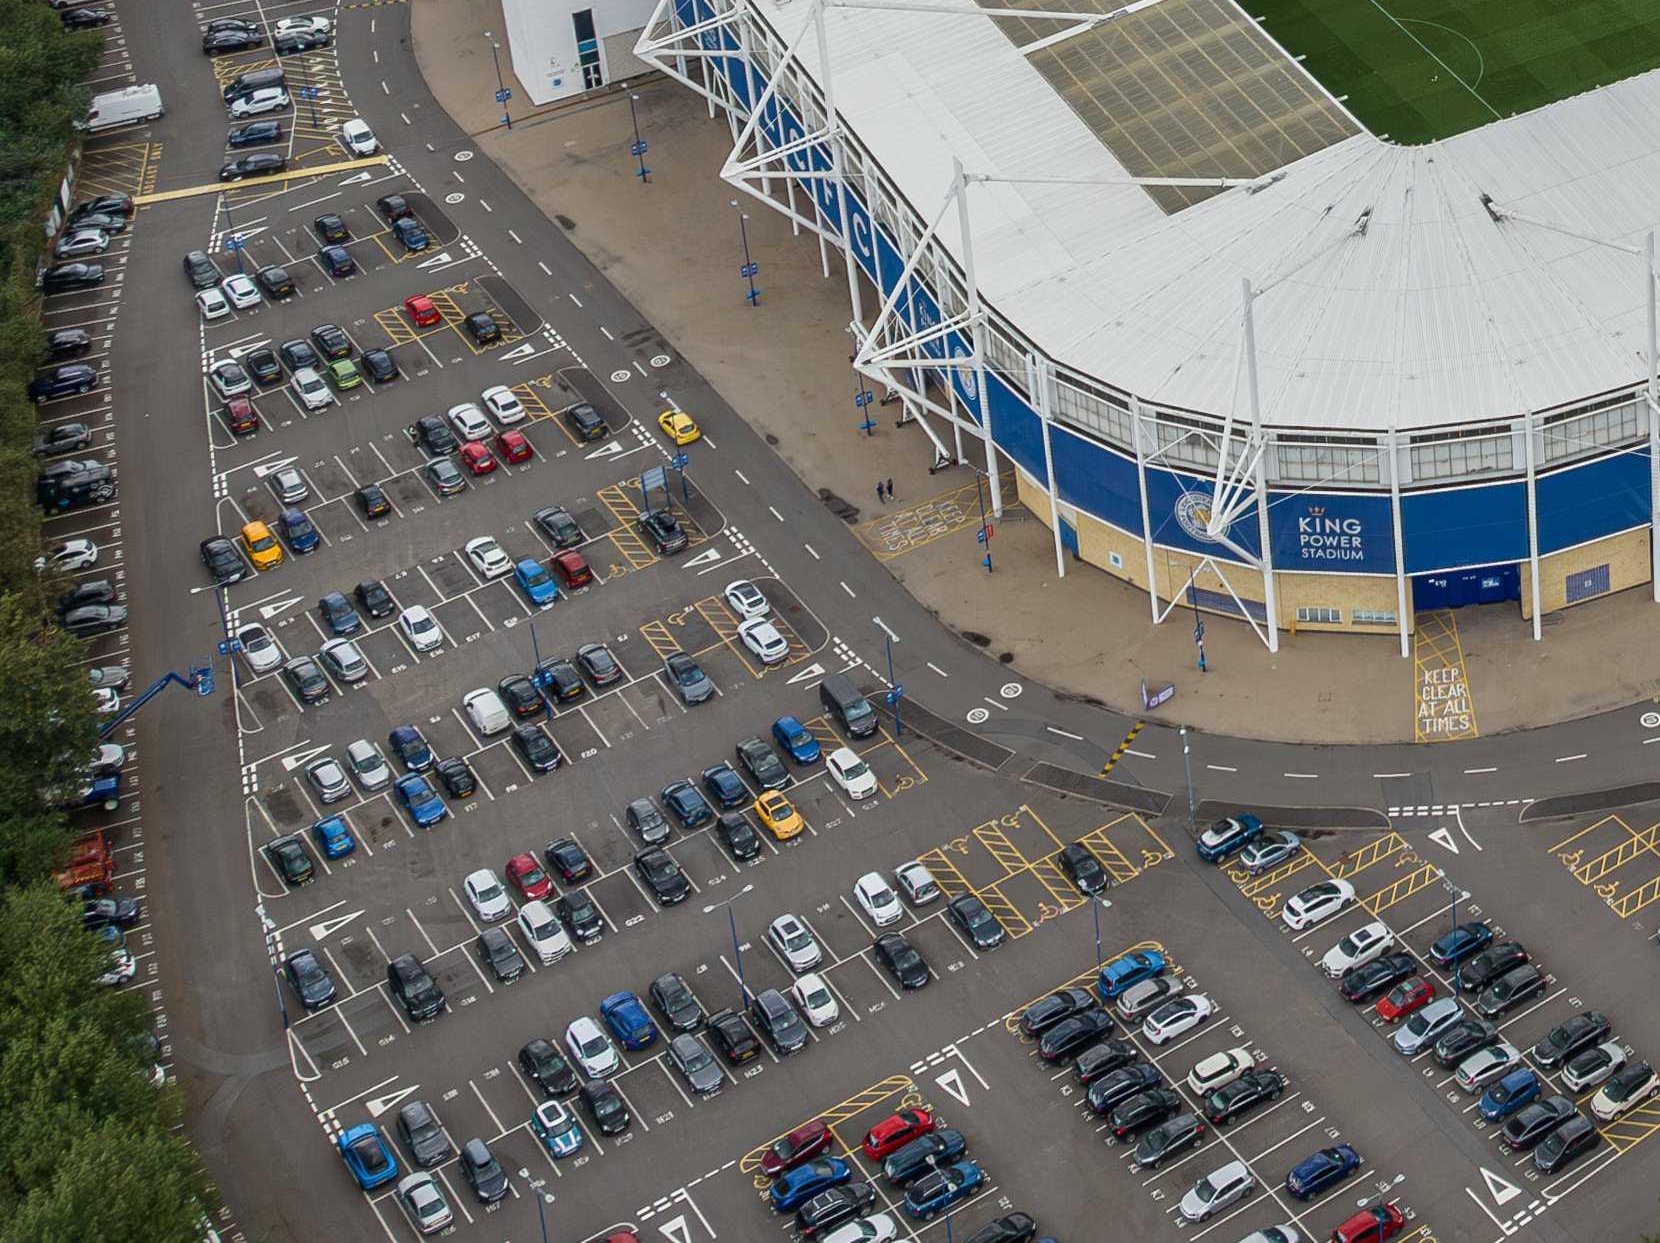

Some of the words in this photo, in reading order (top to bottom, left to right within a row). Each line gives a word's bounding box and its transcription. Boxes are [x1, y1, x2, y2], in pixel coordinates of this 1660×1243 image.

[1298, 516, 1362, 534] KING
[1300, 534, 1362, 549] POWER
[1301, 548, 1364, 561] STADIUM
[1424, 667, 1460, 684] KEEP
[1422, 683, 1467, 700] CLEAR
[1418, 701, 1442, 718] AT
[1443, 698, 1470, 715] ALL
[1422, 716, 1471, 733] TIMES
